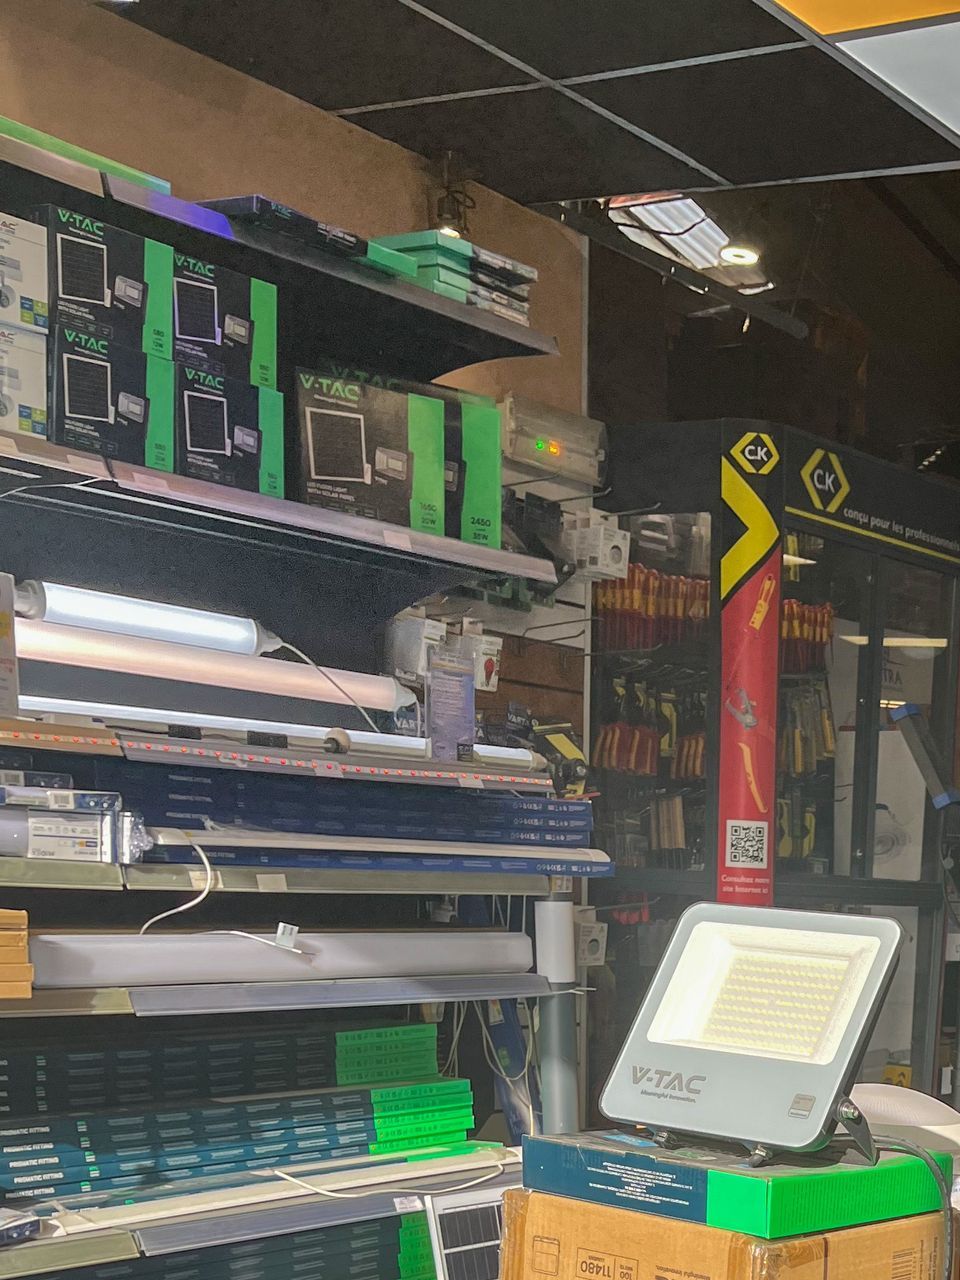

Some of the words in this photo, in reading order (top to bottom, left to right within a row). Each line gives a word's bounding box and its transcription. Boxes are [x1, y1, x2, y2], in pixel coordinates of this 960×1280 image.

[57, 208, 104, 236] V-TAC
[174, 253, 215, 277] V-TAC
[64, 328, 109, 354] V-TAC
[184, 367, 224, 389] V-TAC
[300, 373, 360, 401] V-TAC
[870, 516, 890, 530] pour
[632, 1065, 707, 1095] V-TAC
[580, 1260, 612, 1279] 11480
